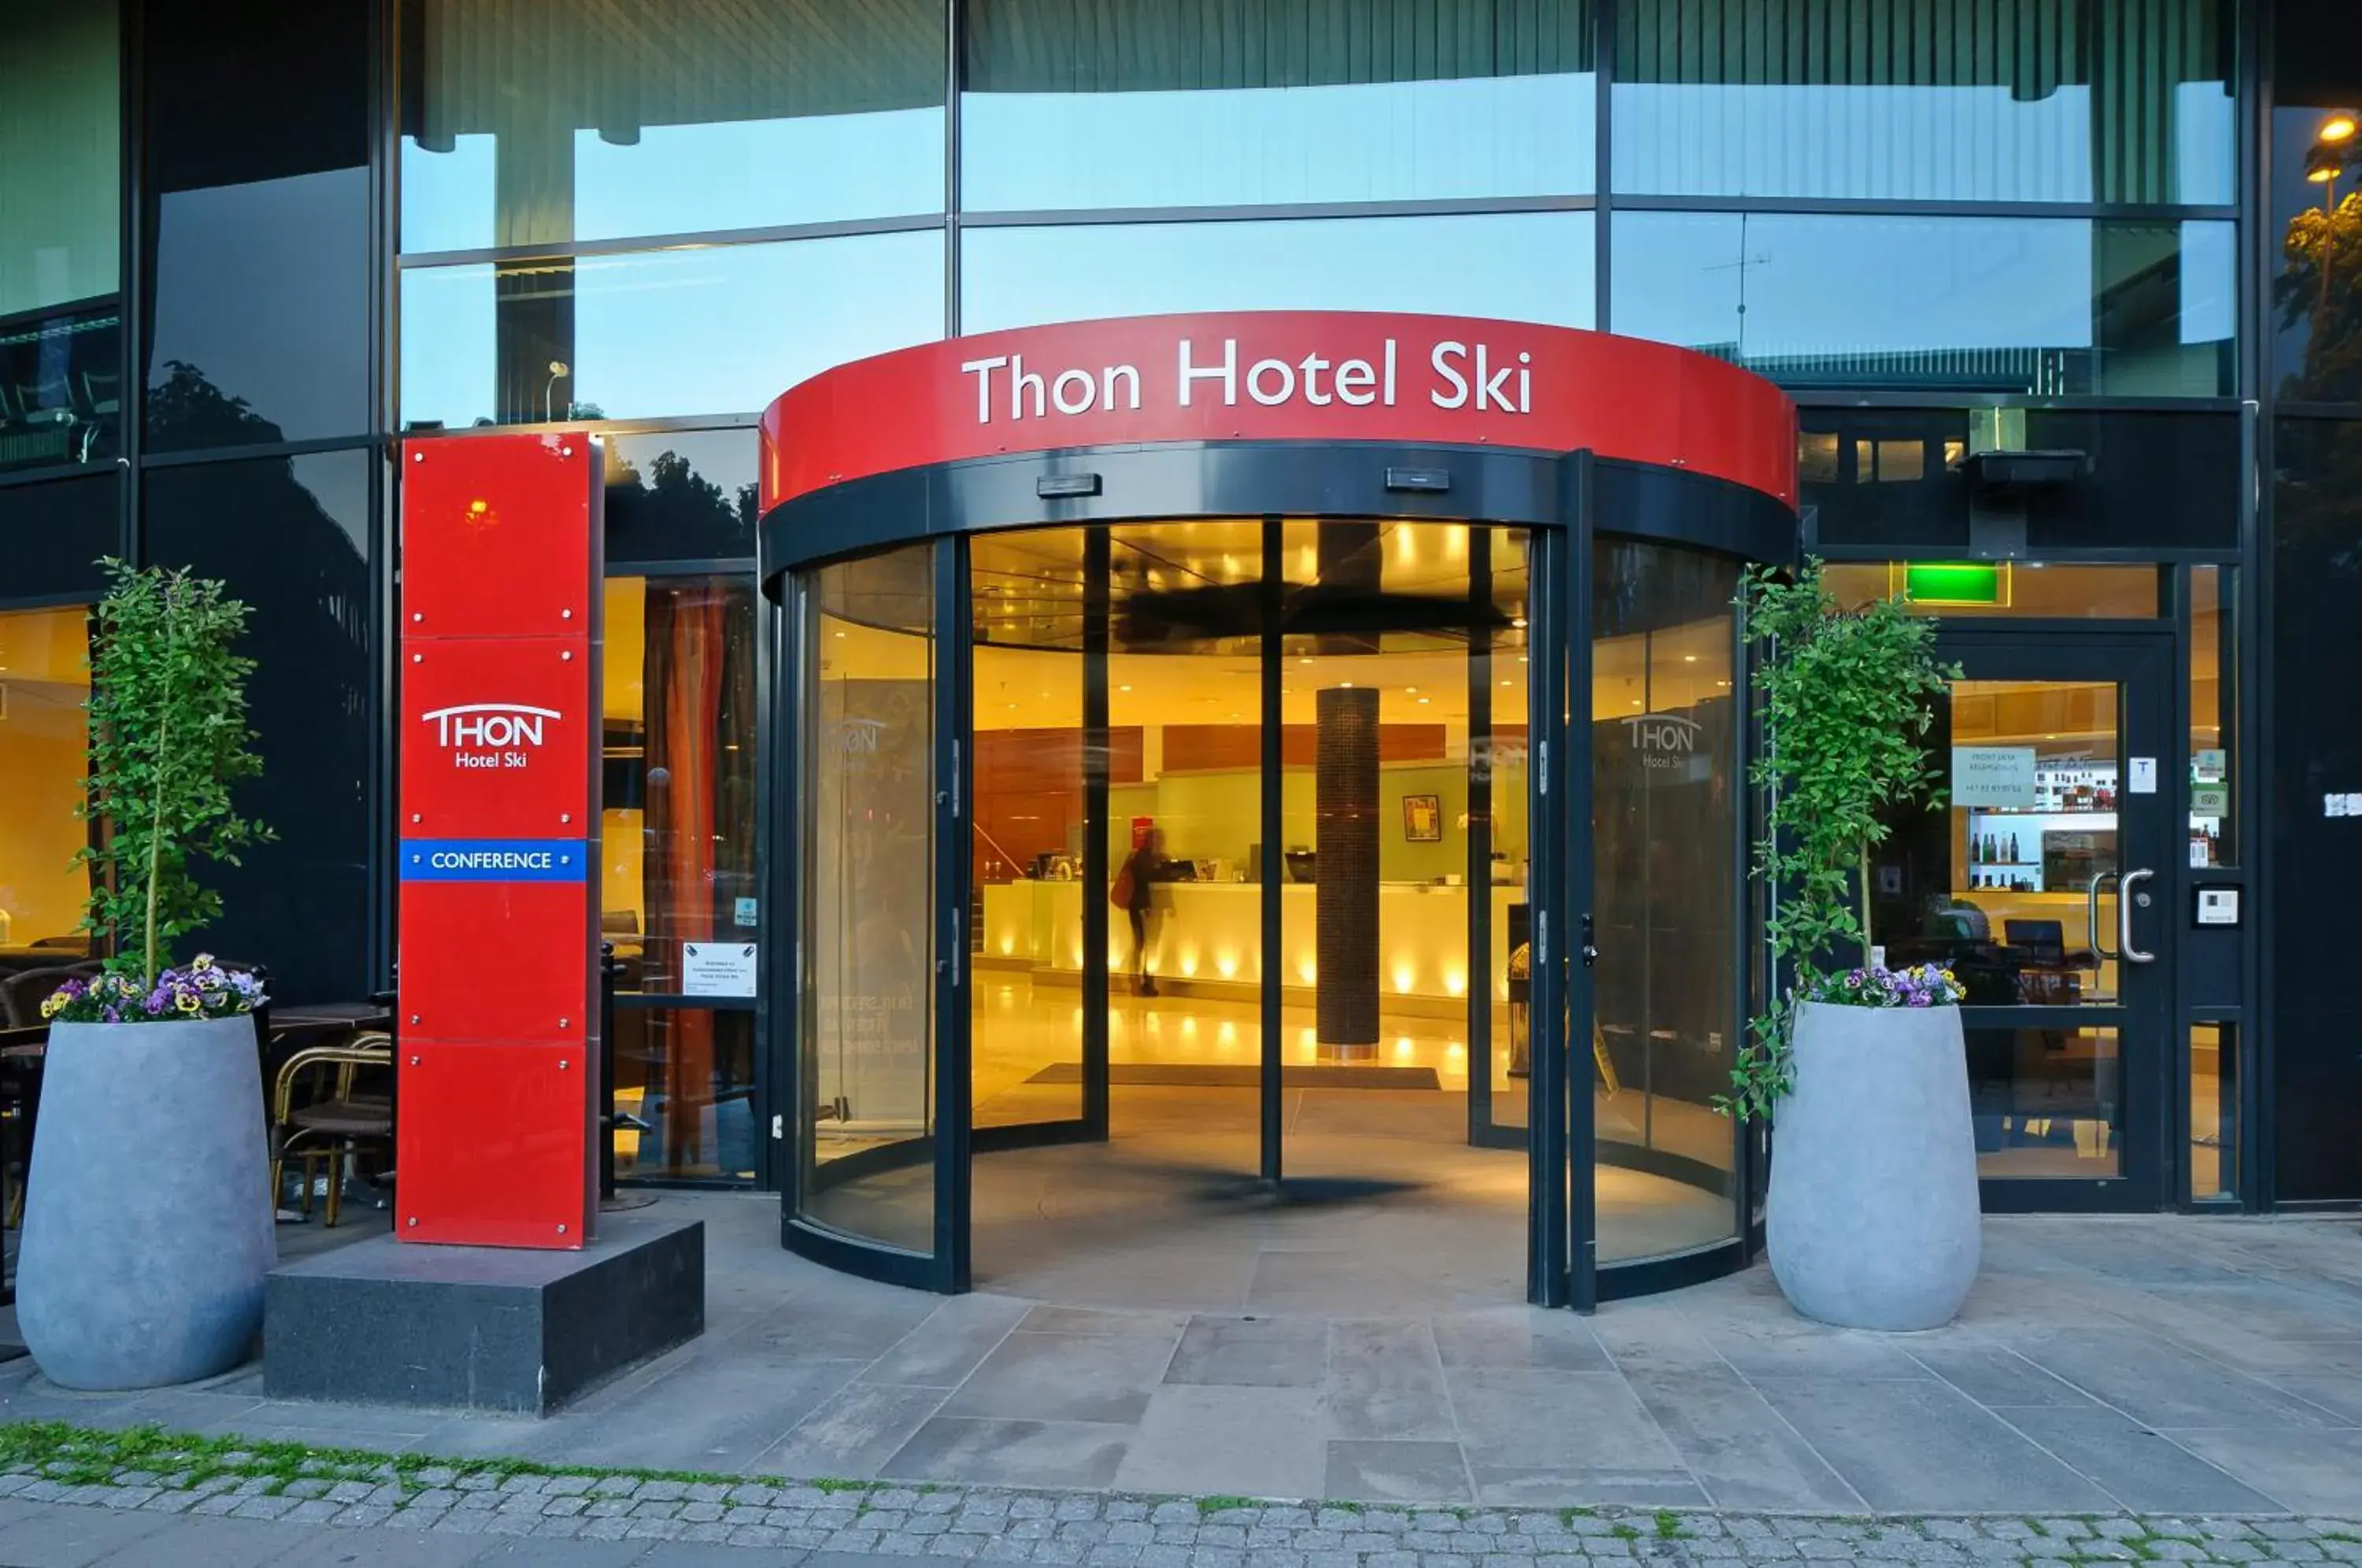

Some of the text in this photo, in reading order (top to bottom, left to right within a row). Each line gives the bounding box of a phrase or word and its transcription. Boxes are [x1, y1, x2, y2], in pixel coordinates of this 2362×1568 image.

[961, 338, 1531, 423] Thon Hotel Ski
[422, 703, 561, 747] THON
[1620, 714, 1703, 753] THON
[455, 752, 527, 768] Hotel Ski
[431, 852, 552, 869] CONFERENCE
